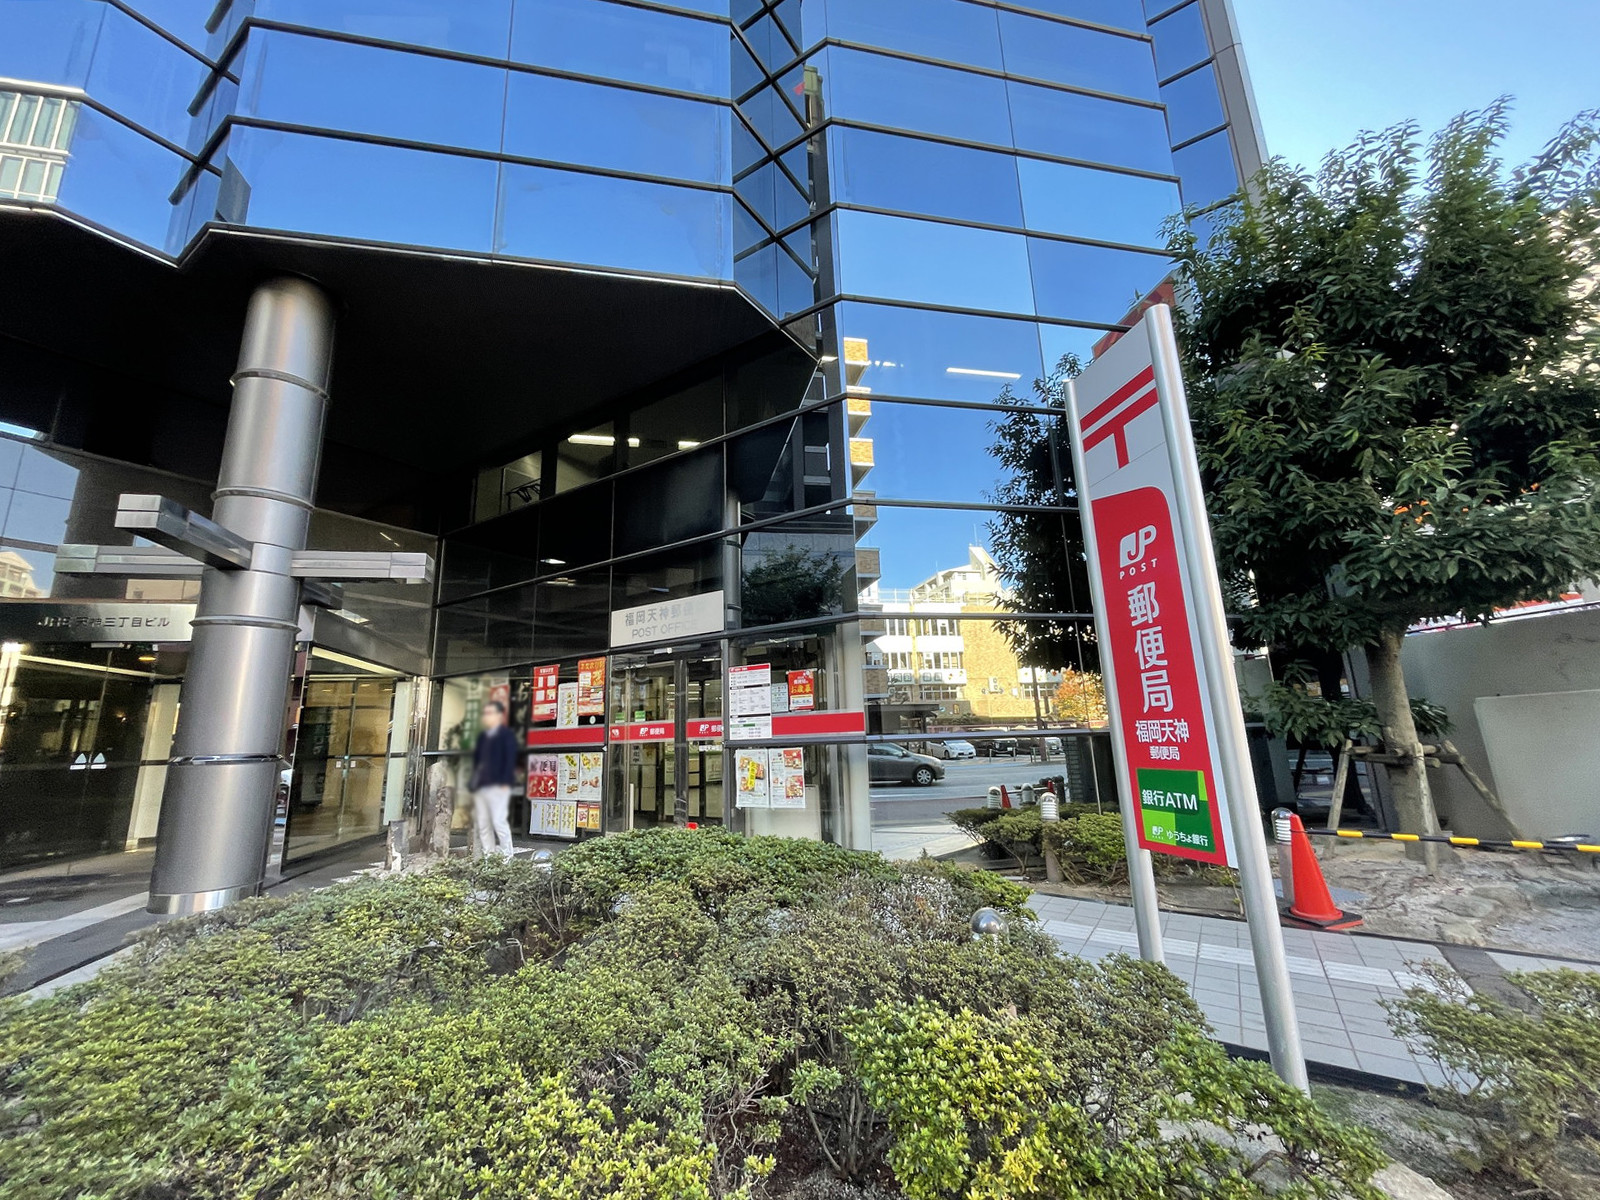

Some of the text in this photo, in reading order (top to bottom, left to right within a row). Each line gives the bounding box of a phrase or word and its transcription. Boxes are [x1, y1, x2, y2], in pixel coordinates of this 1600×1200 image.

[1120, 558, 1158, 580] POST
[625, 600, 705, 627] 福岡天神郵便
[631, 619, 697, 639] POST OFFI
[1127, 581, 1174, 714] 郵便局
[1135, 718, 1190, 743] 福岡天神
[1149, 745, 1181, 761] 郵便局
[1141, 788, 1199, 811] 銀行ATM
[1166, 829, 1209, 847] ゆうちょ銀行
